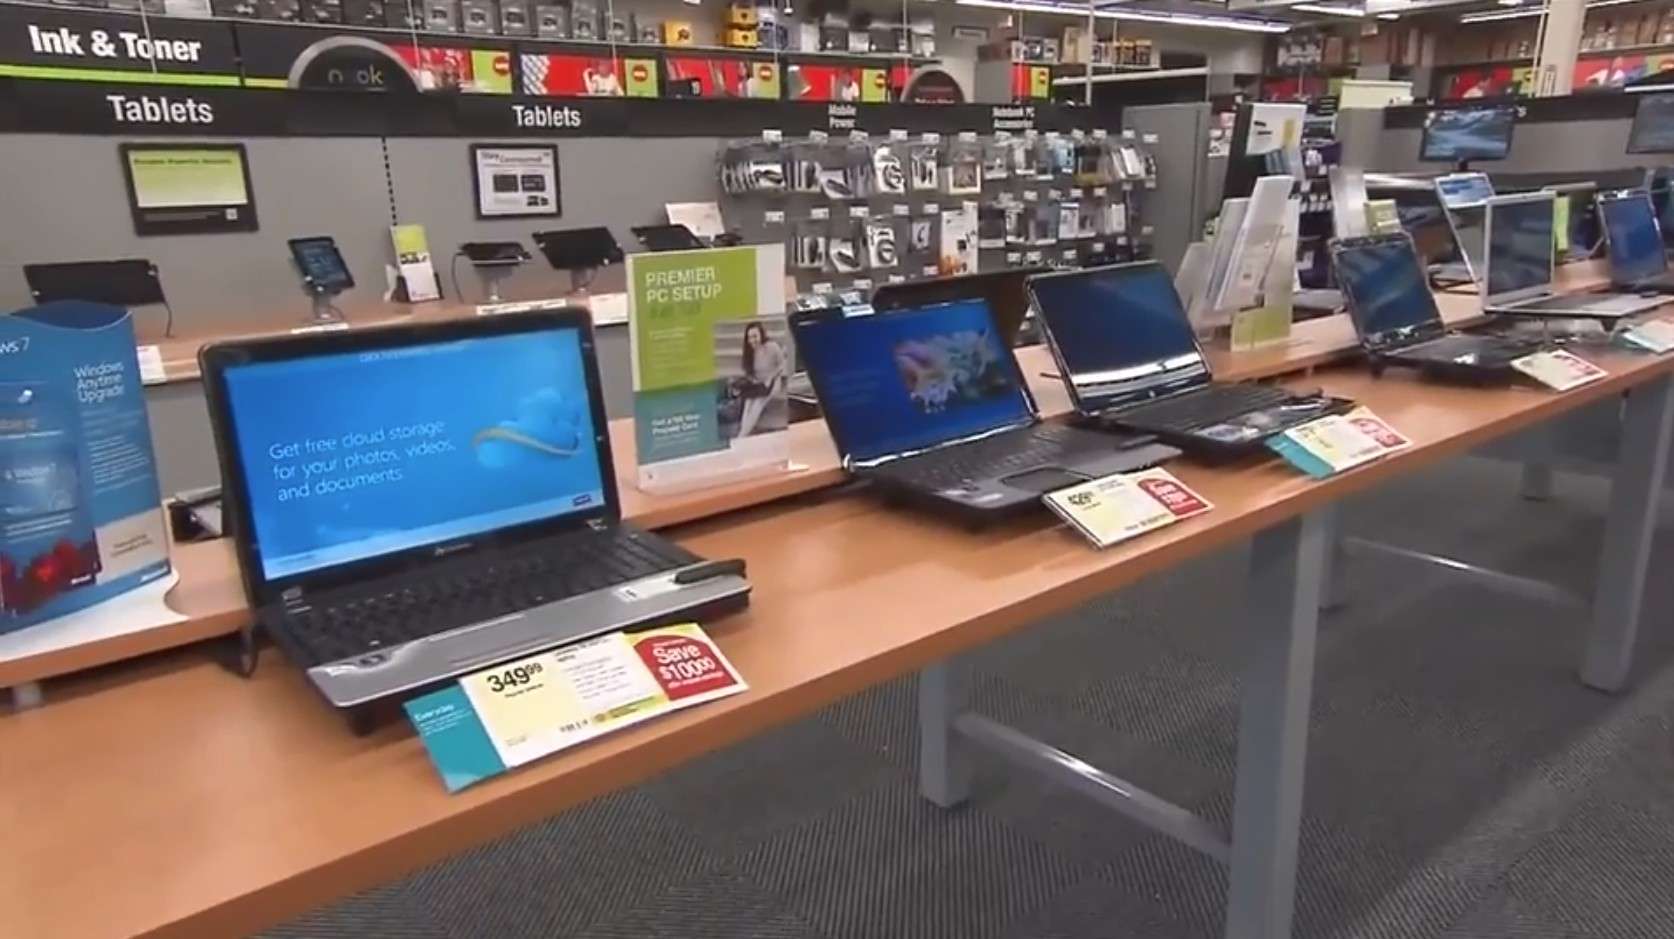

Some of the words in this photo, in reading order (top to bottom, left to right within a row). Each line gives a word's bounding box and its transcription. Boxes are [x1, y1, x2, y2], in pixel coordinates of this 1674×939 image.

[28, 25, 85, 55] Ink
[90, 30, 117, 57] &
[119, 32, 201, 61] Toner
[106, 95, 214, 124] Tablets
[511, 105, 581, 127] Tablets
[828, 103, 857, 116] Mobile
[828, 116, 856, 129] Power
[645, 266, 716, 287] PREMIER
[646, 288, 669, 303] PC
[672, 283, 723, 302] SETUP
[21, 337, 30, 350] 7
[73, 361, 125, 378] Windows
[269, 442, 301, 459] Get
[304, 438, 338, 453] free
[341, 427, 385, 448] cloud
[389, 420, 446, 441] storage
[273, 464, 297, 480] for
[302, 458, 338, 479] your
[277, 482, 310, 501] and
[652, 644, 702, 664] Save
